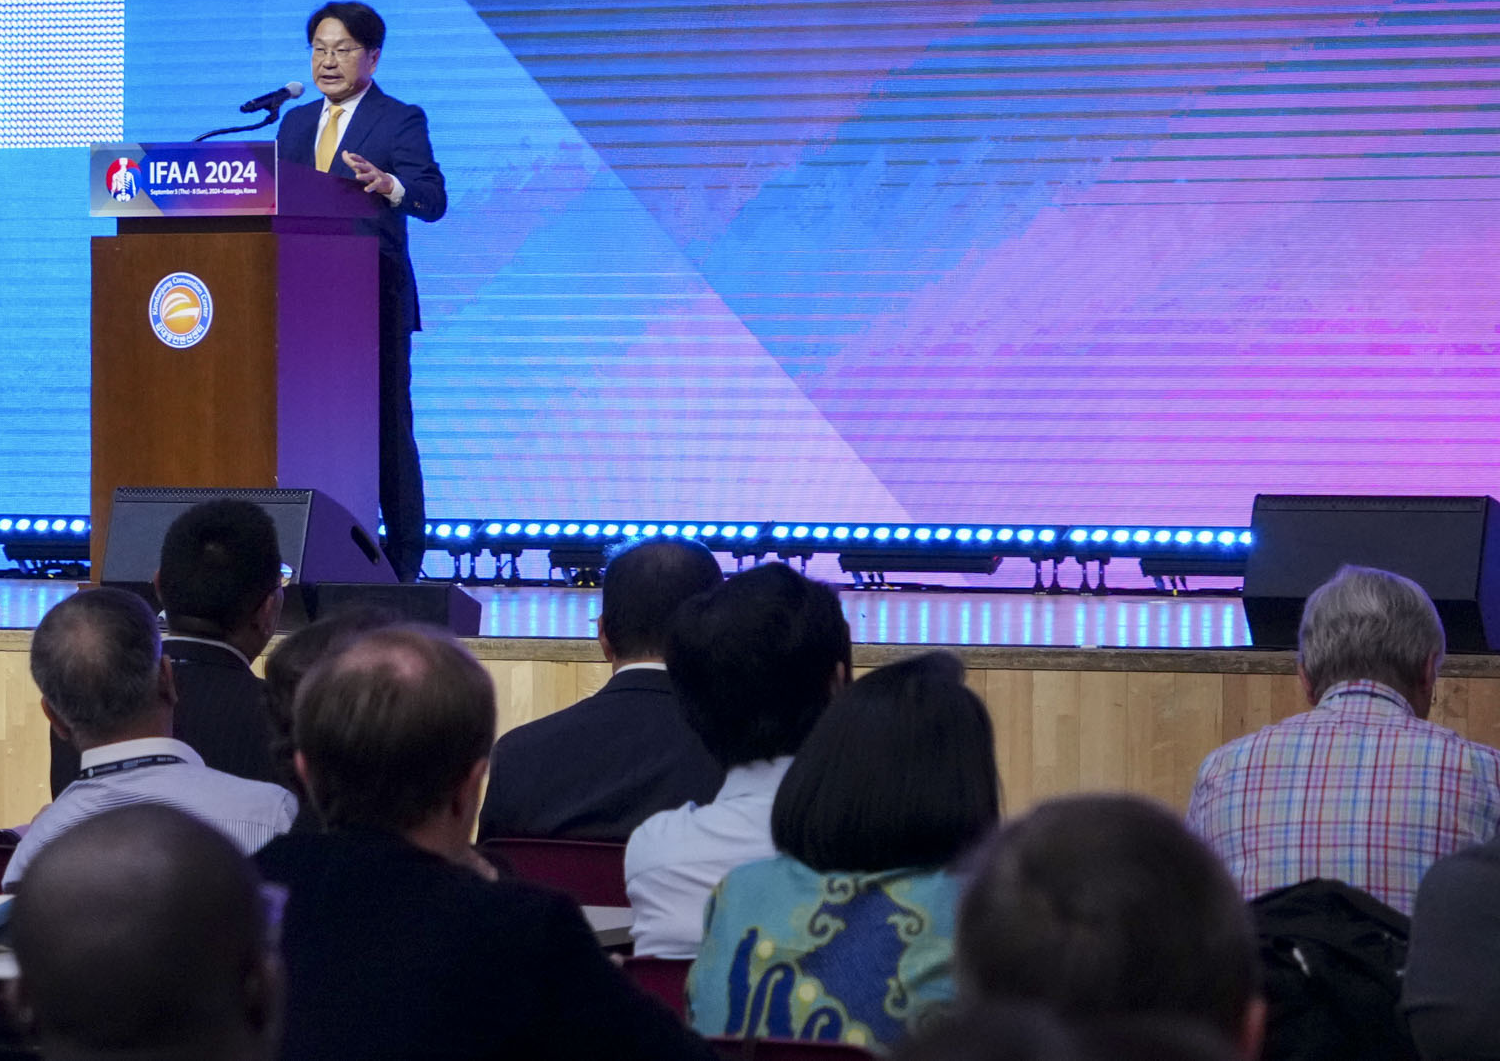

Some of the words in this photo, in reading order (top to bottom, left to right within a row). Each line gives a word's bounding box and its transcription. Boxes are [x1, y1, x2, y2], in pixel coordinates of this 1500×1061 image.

[149, 160, 200, 184] IFAA
[204, 159, 258, 184] 2024
[200, 293, 209, 318] Center
